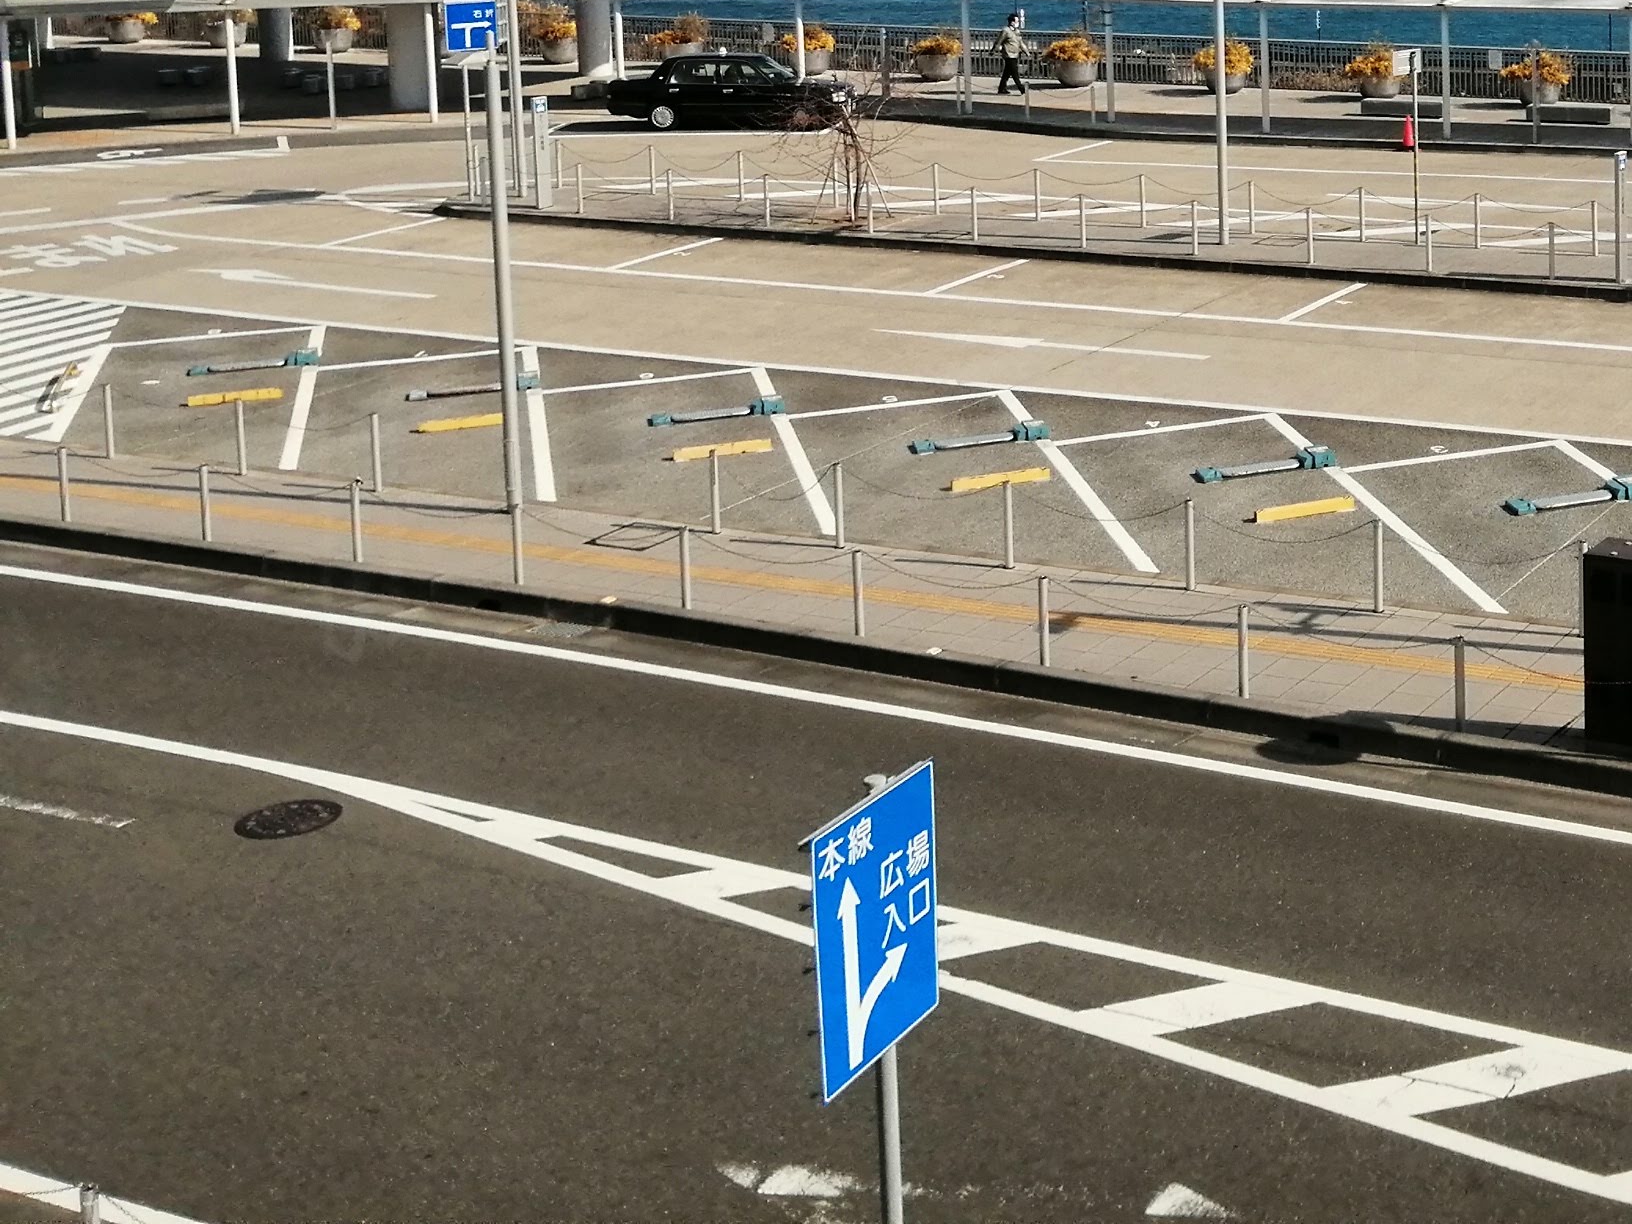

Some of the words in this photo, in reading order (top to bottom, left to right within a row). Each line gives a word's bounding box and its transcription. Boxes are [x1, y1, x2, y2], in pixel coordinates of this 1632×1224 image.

[818, 816, 874, 882] 本線
[880, 829, 930, 899] 広場
[882, 877, 931, 949] 入口
